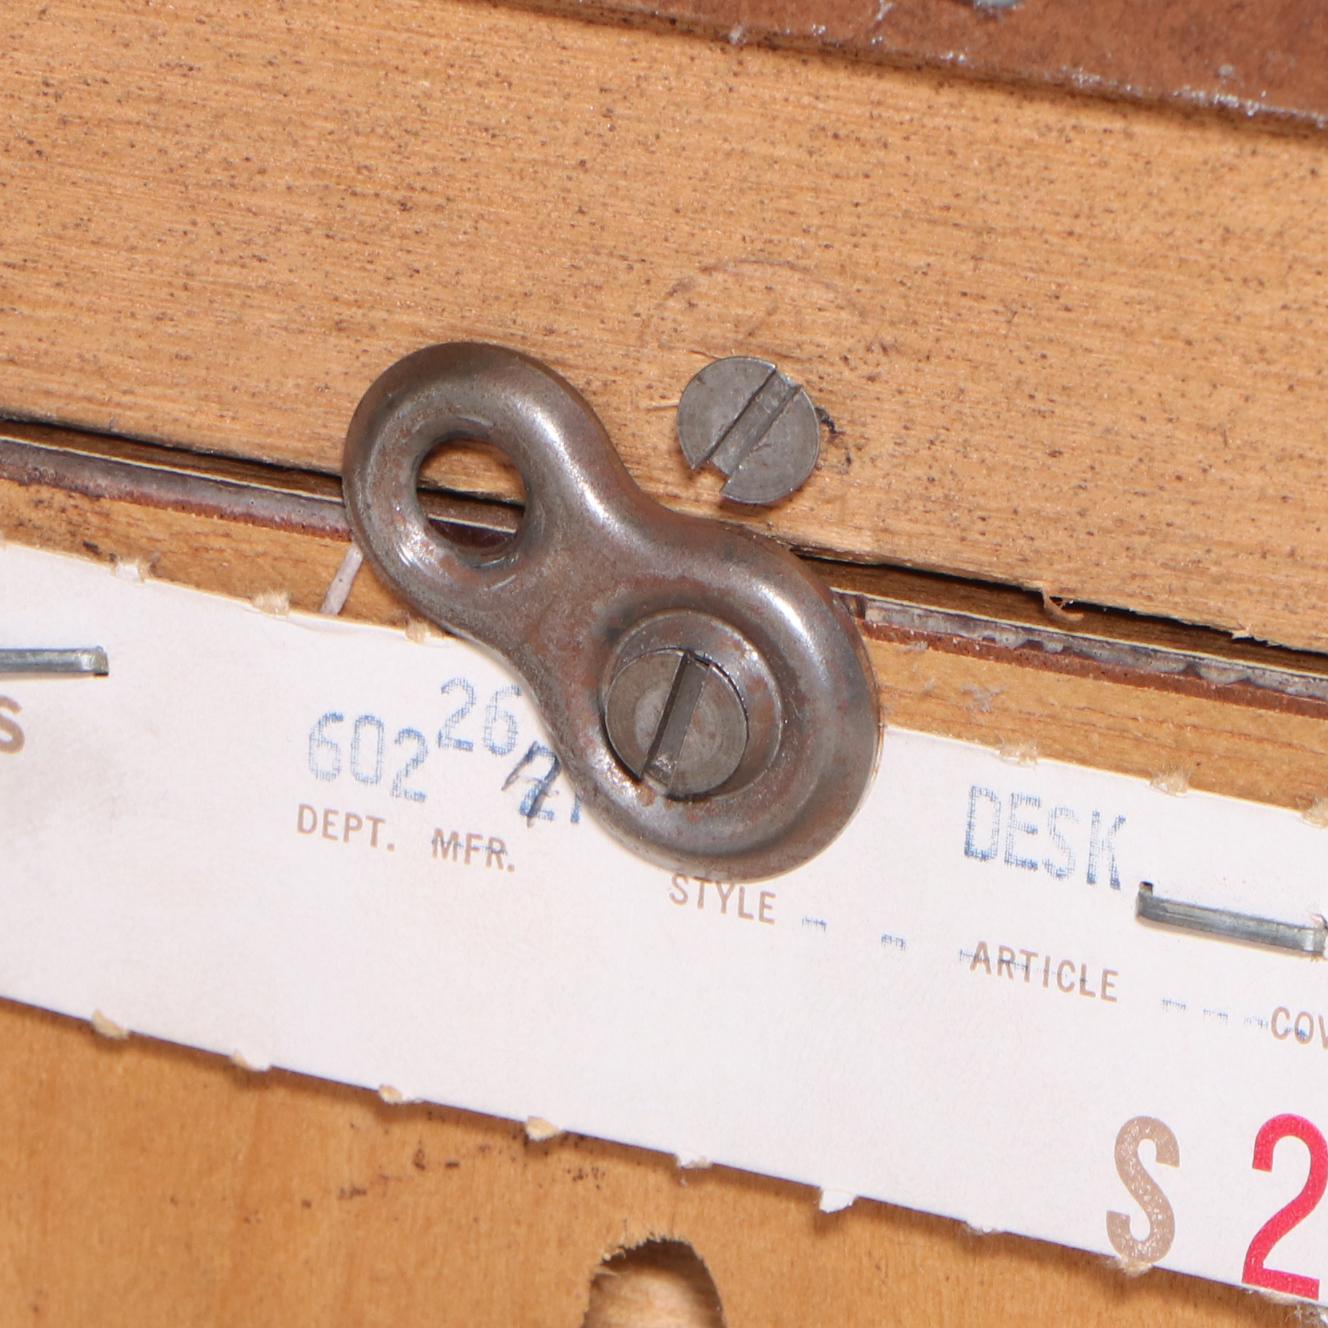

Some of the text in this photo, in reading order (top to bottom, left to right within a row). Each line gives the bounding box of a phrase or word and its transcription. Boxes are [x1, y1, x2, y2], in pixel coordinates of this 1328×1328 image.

[307, 710, 429, 804] 602
[963, 784, 1127, 891] DESK
[295, 802, 396, 853] DEPT.
[430, 827, 516, 873] MFR.
[668, 872, 777, 926] STYLE
[969, 940, 1120, 1003] ARTICLE
[1105, 1116, 1181, 1264] S
